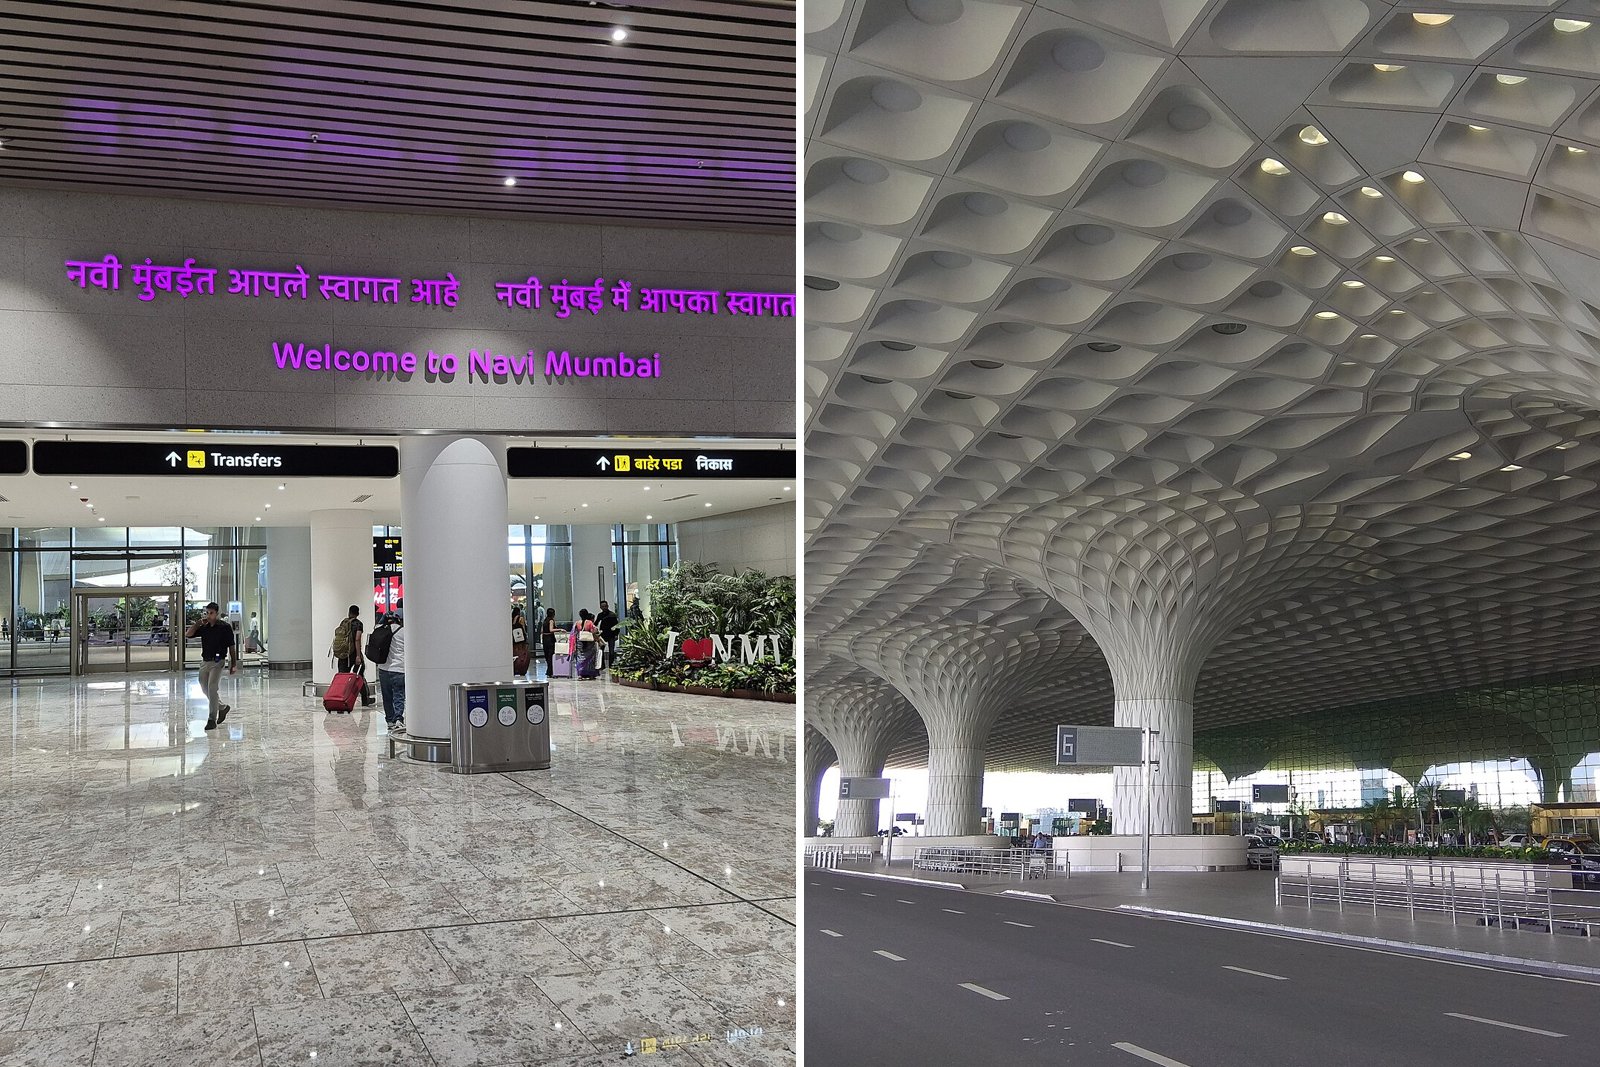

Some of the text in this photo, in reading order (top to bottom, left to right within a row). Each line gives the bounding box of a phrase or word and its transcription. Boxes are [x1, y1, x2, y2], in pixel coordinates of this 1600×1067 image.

[65, 253, 460, 308] नवी मुंबईत आपले स्वागत आहे
[495, 276, 796, 319] नवी मुंबई में आपका स्वागत
[272, 342, 661, 379] Welcome to Navi Mumbai
[211, 452, 282, 468] Transfers
[634, 455, 733, 471] बाहेर पडा निकास
[1063, 734, 1074, 756] 6
[841, 782, 849, 795] 5
[1254, 788, 1260, 799] 5
